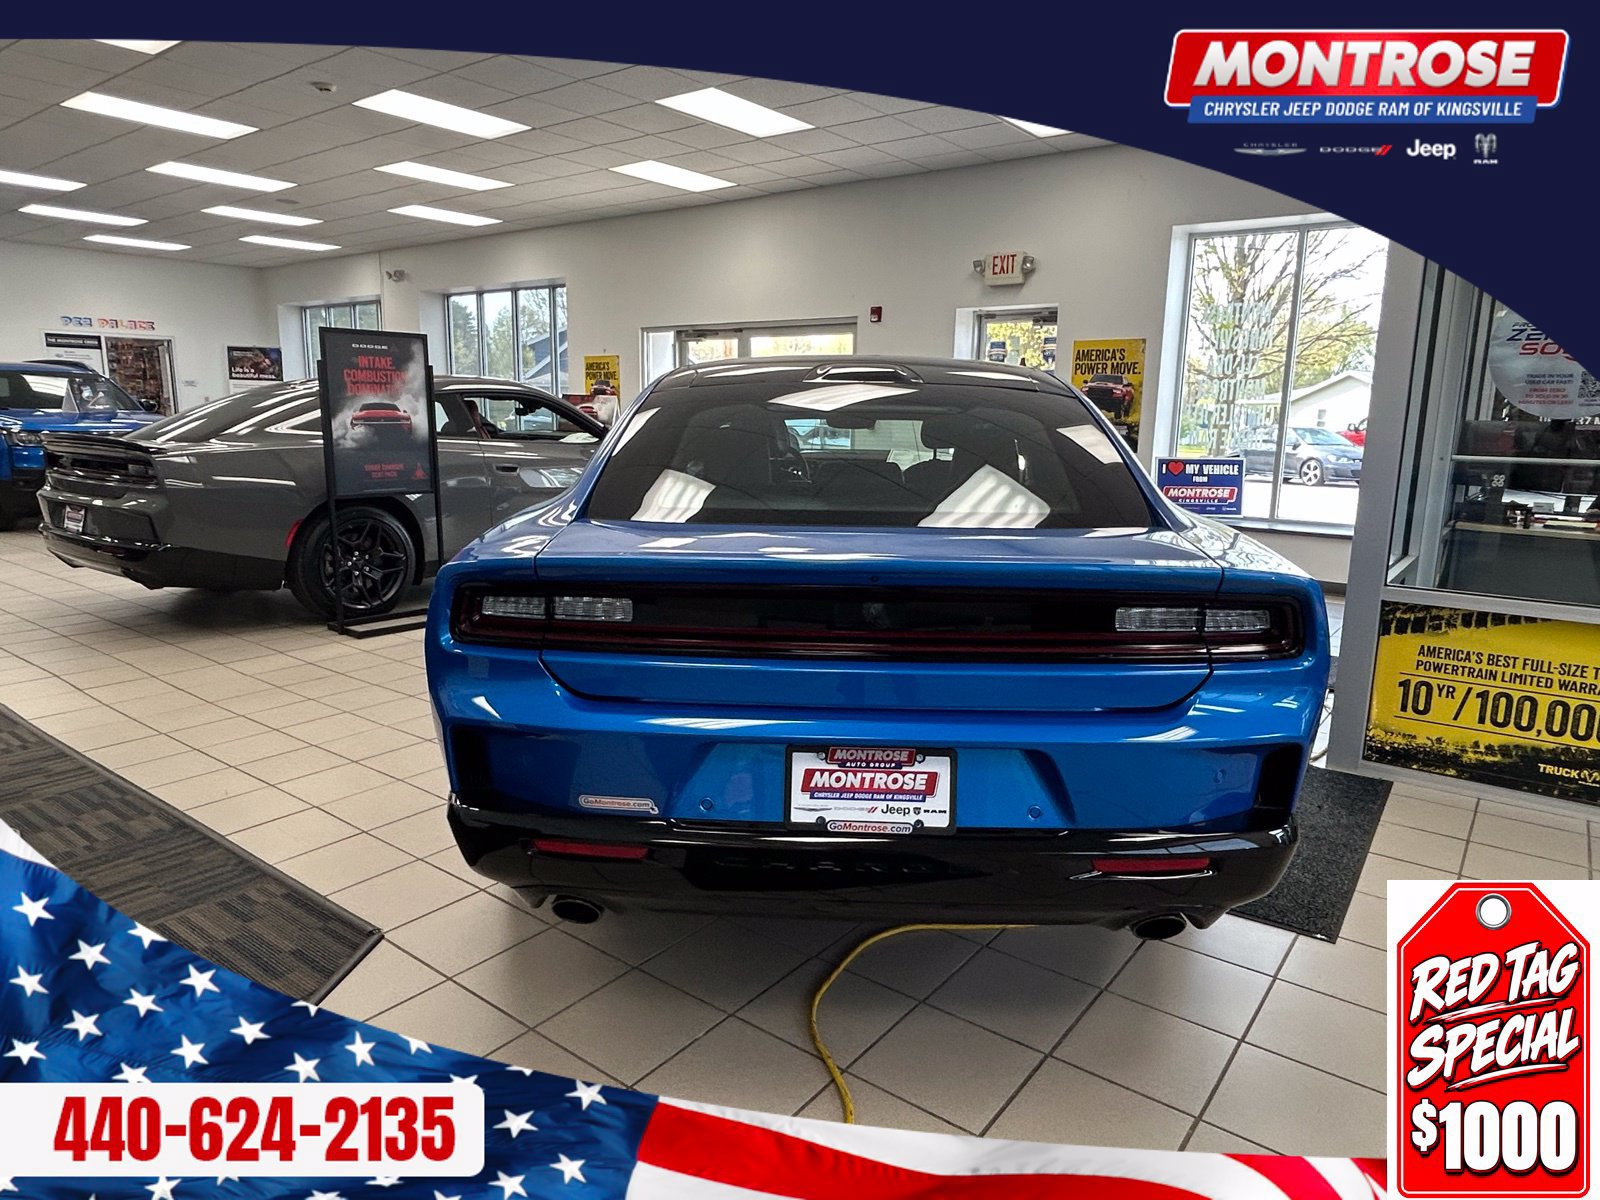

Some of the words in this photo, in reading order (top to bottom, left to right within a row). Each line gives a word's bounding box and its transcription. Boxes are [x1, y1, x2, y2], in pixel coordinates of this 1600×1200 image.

[992, 254, 1017, 276] EXIT
[1075, 348, 1125, 362] AMERICA'S
[358, 355, 395, 369] INTAKE.
[585, 362, 610, 371] AMERICA'S
[1074, 362, 1108, 375] POWER
[1110, 362, 1141, 375] MOVE.
[585, 371, 603, 380] POWER
[1162, 464, 1166, 474] I
[1185, 463, 1200, 474] MY
[1203, 464, 1239, 475] VEHICLE
[1167, 488, 1231, 498] MONTROSE
[1418, 645, 1483, 665] AMERICA'S
[1487, 653, 1519, 669] BEST
[1522, 658, 1588, 679] FULL-SIZE
[1416, 659, 1498, 682] POWERTRAIN
[1501, 671, 1553, 689] LIMITED
[1398, 678, 1433, 716] 10
[1437, 684, 1456, 699] YR
[834, 749, 909, 761] MONTROSE
[1538, 764, 1580, 779] TRUCK
[810, 771, 928, 791] MONTROSE
[814, 791, 840, 799] CHRYSLER
[583, 797, 650, 808] GoMontrose.com
[881, 804, 911, 816] Jeep
[829, 822, 911, 834] GoMontrose.com
